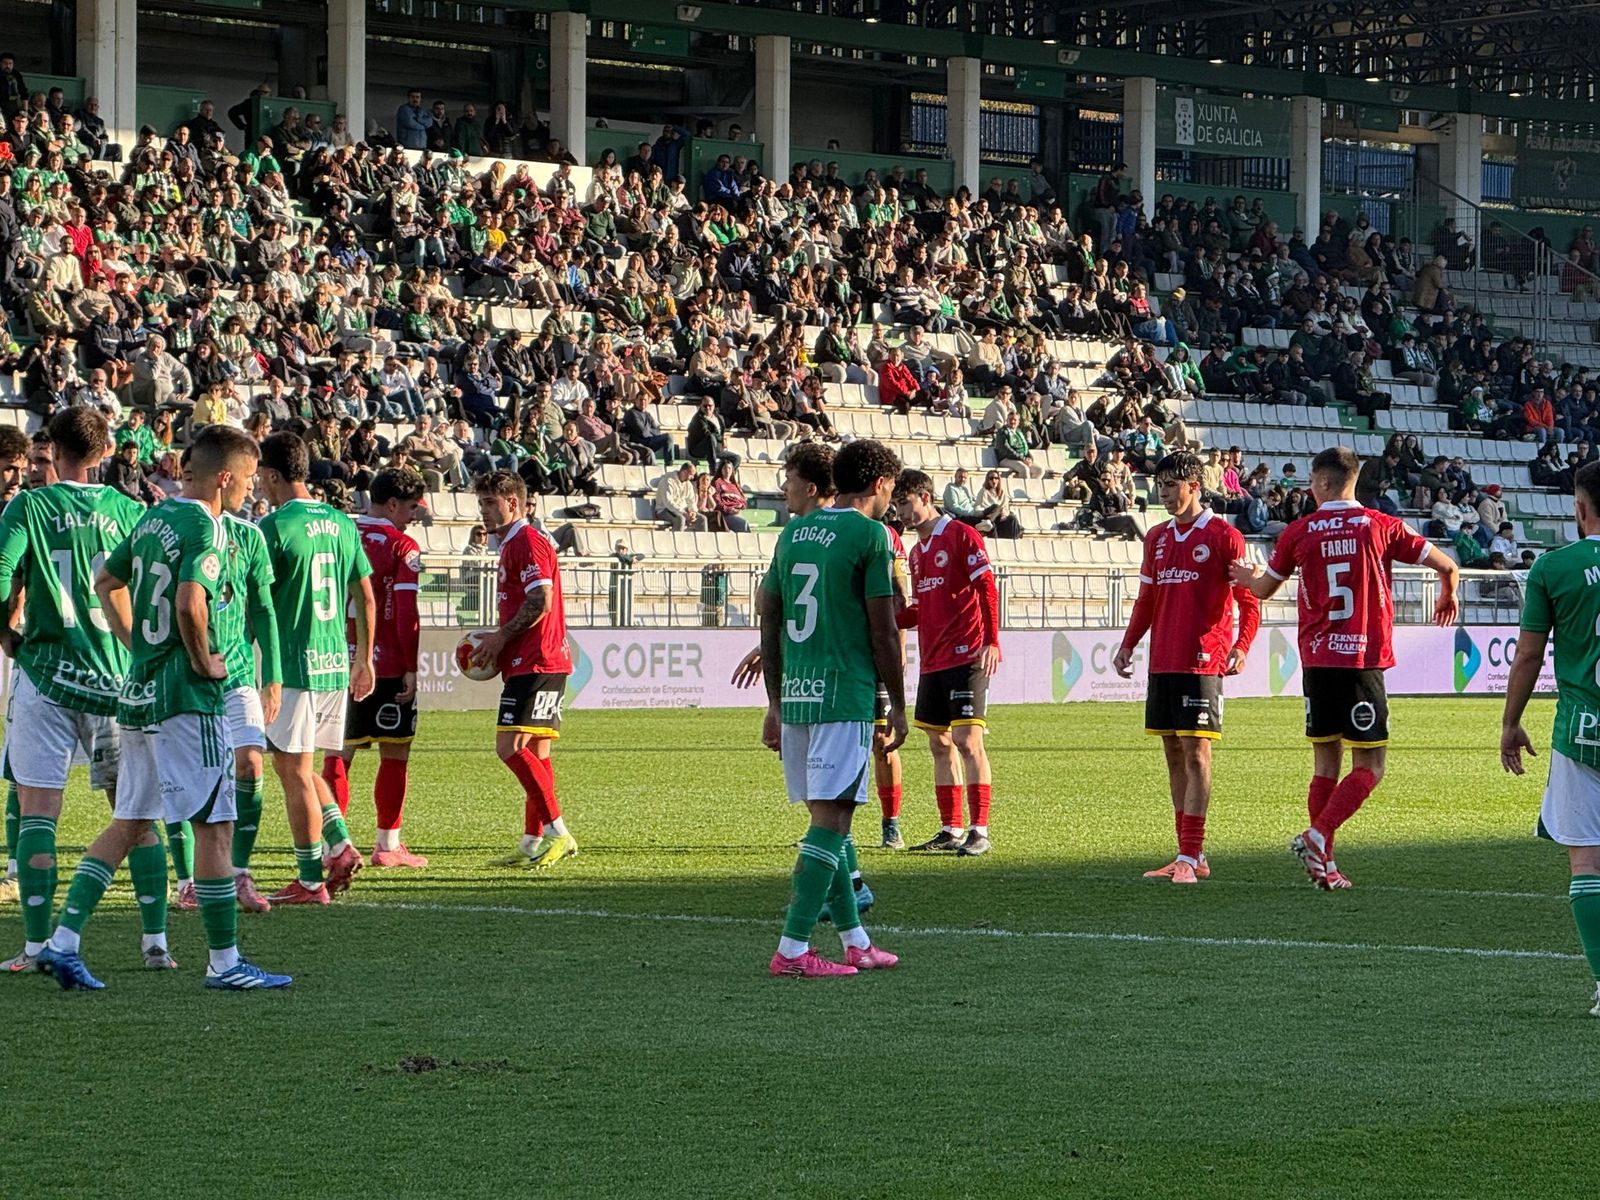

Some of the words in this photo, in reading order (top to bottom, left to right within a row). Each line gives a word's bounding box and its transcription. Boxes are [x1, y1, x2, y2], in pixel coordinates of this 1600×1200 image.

[1197, 103, 1238, 124] XUNTA
[1197, 125, 1213, 143] DE
[1216, 127, 1263, 147] GALICIA
[51, 511, 118, 537] ZALAYA
[305, 519, 340, 538] JAIRO
[1307, 517, 1343, 533] MMG
[792, 526, 836, 548] EDGAR
[1321, 538, 1356, 557] FARRU
[311, 552, 337, 621] 5
[1327, 562, 1354, 621] 5
[787, 562, 819, 643] 3
[602, 642, 703, 678] COFER
